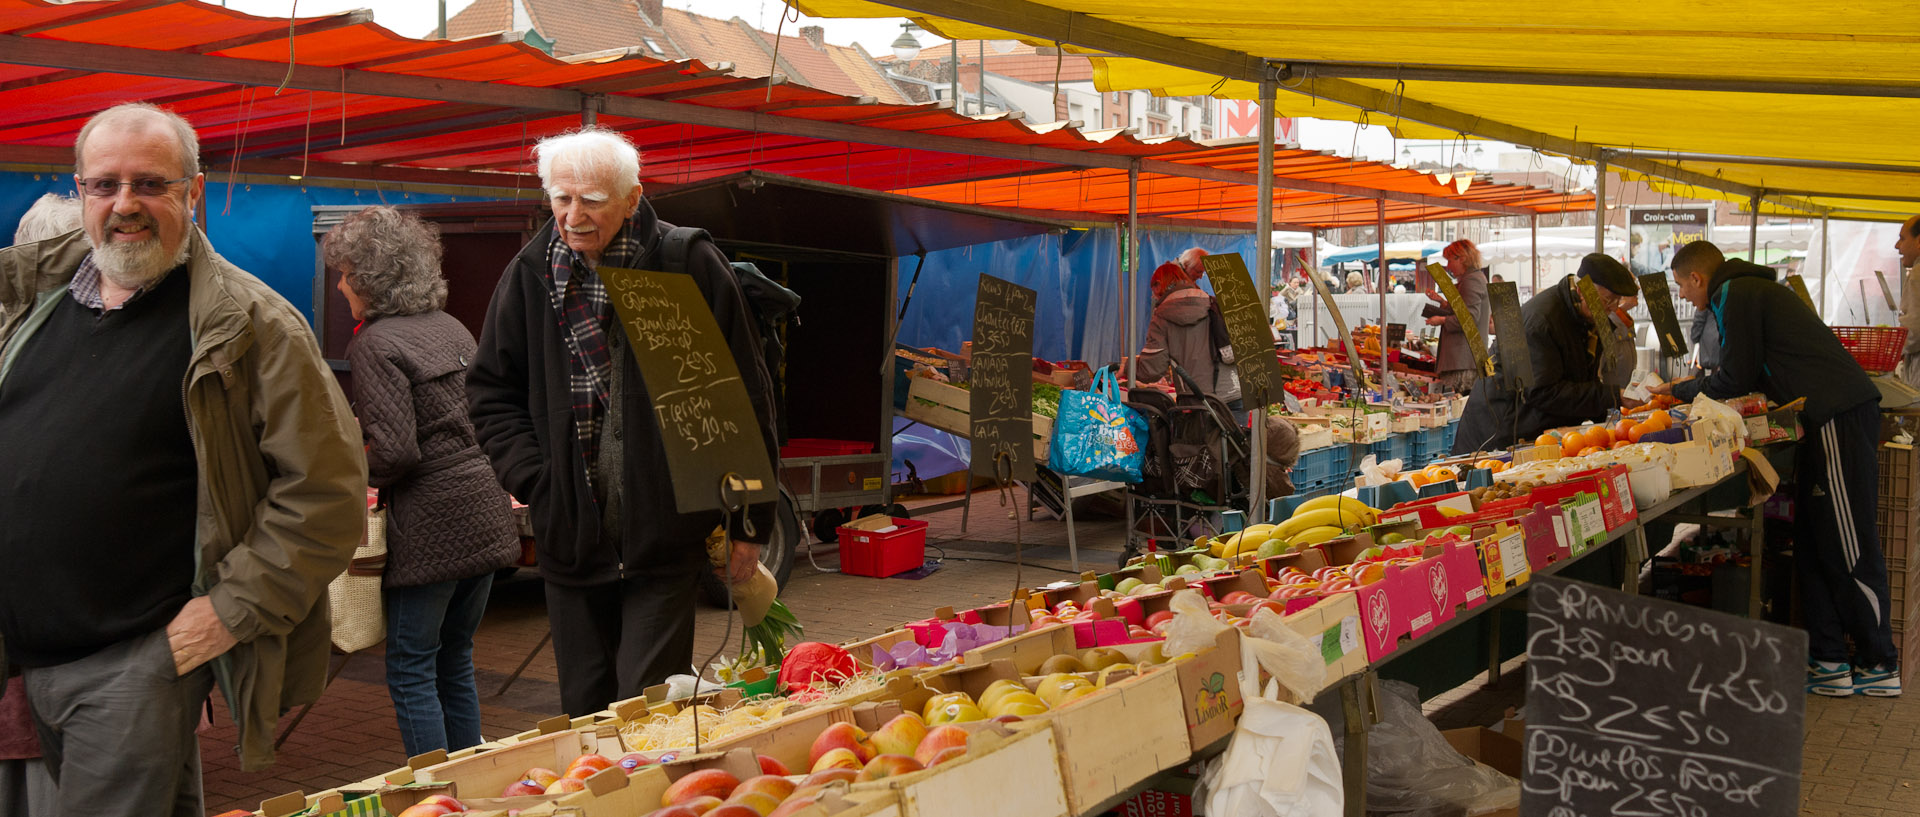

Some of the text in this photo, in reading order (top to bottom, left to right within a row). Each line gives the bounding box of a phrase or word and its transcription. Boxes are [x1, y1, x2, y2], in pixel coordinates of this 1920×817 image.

[1643, 213, 1695, 222] Croix-Centre
[1672, 230, 1704, 246] Merci
[972, 357, 1008, 373] CANADA
[974, 424, 1000, 439] GALA
[1687, 664, 1788, 716] 4€50
[1594, 695, 1730, 746] 2€50
